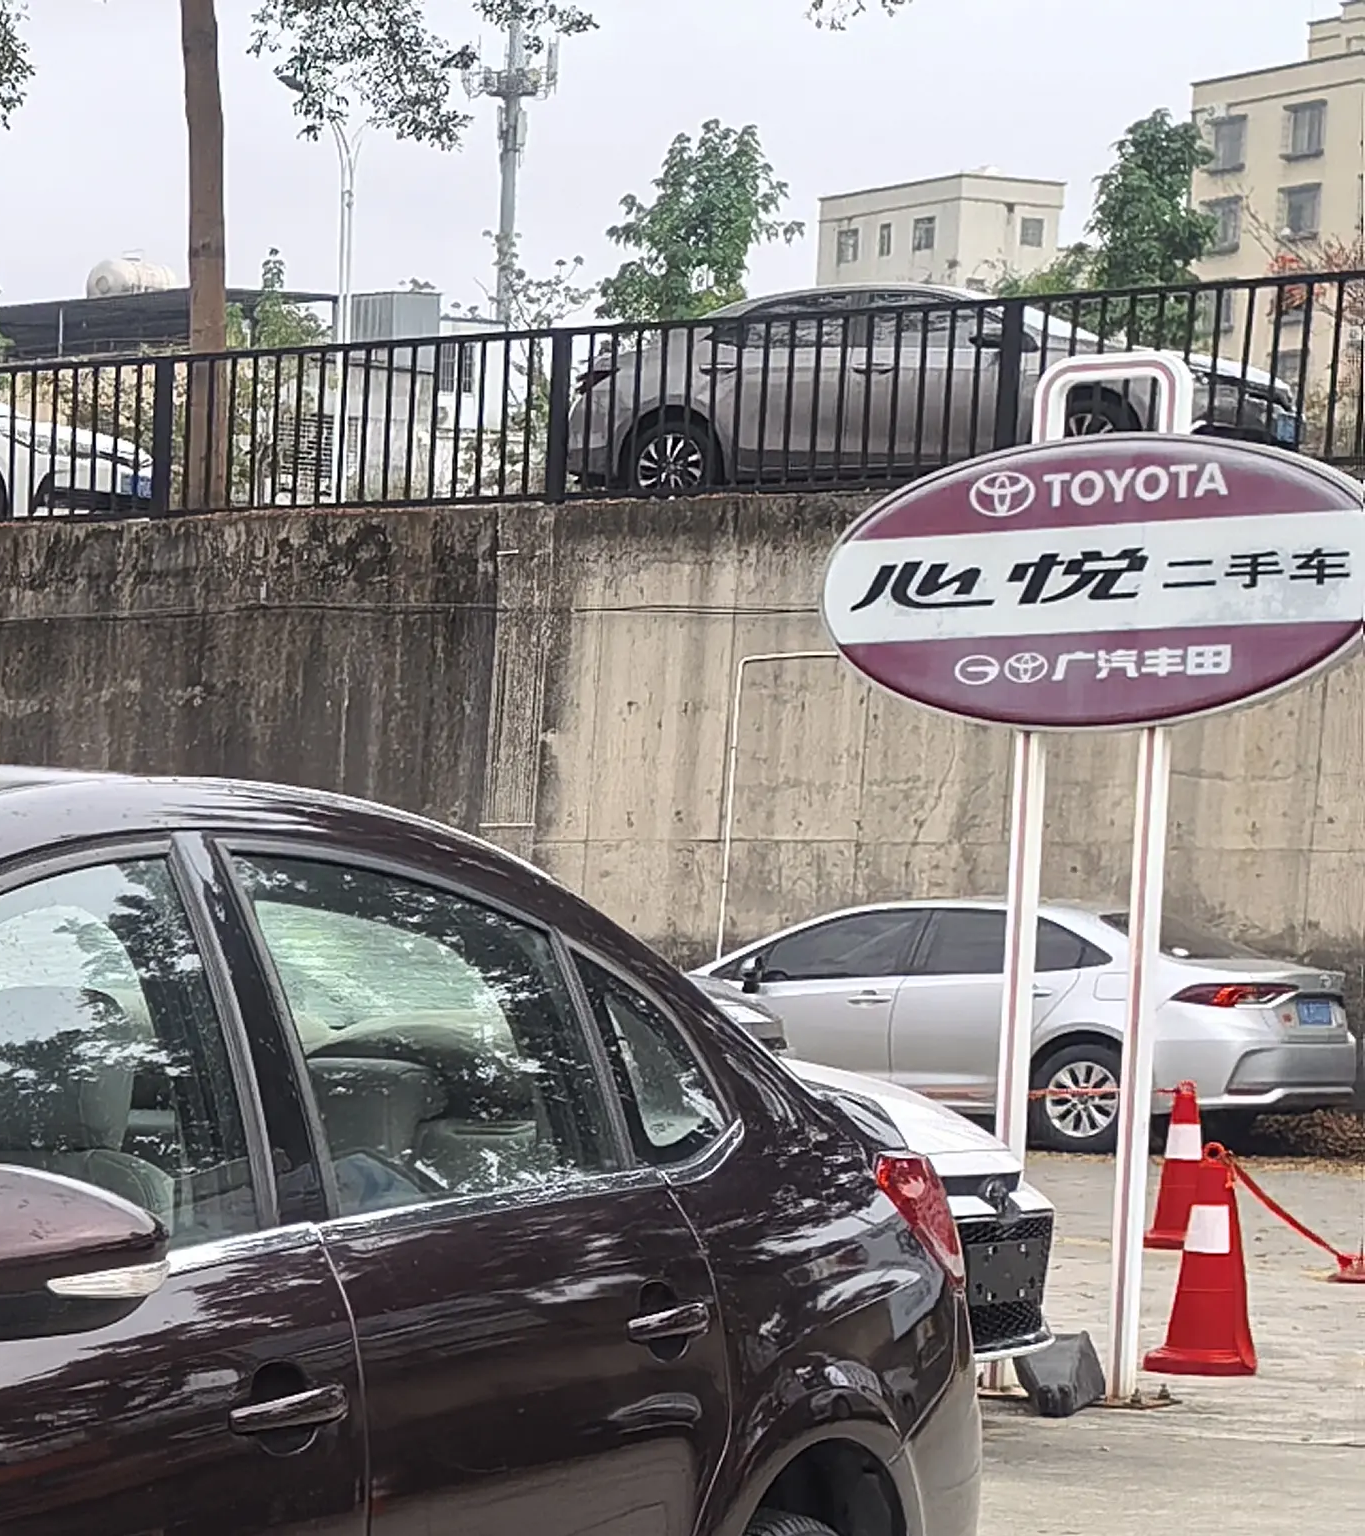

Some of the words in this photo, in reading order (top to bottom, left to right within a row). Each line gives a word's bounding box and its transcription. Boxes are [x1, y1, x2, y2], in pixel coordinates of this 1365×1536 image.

[1042, 463, 1229, 508] TOYOTA
[1050, 643, 1233, 682] 广汽丰田
